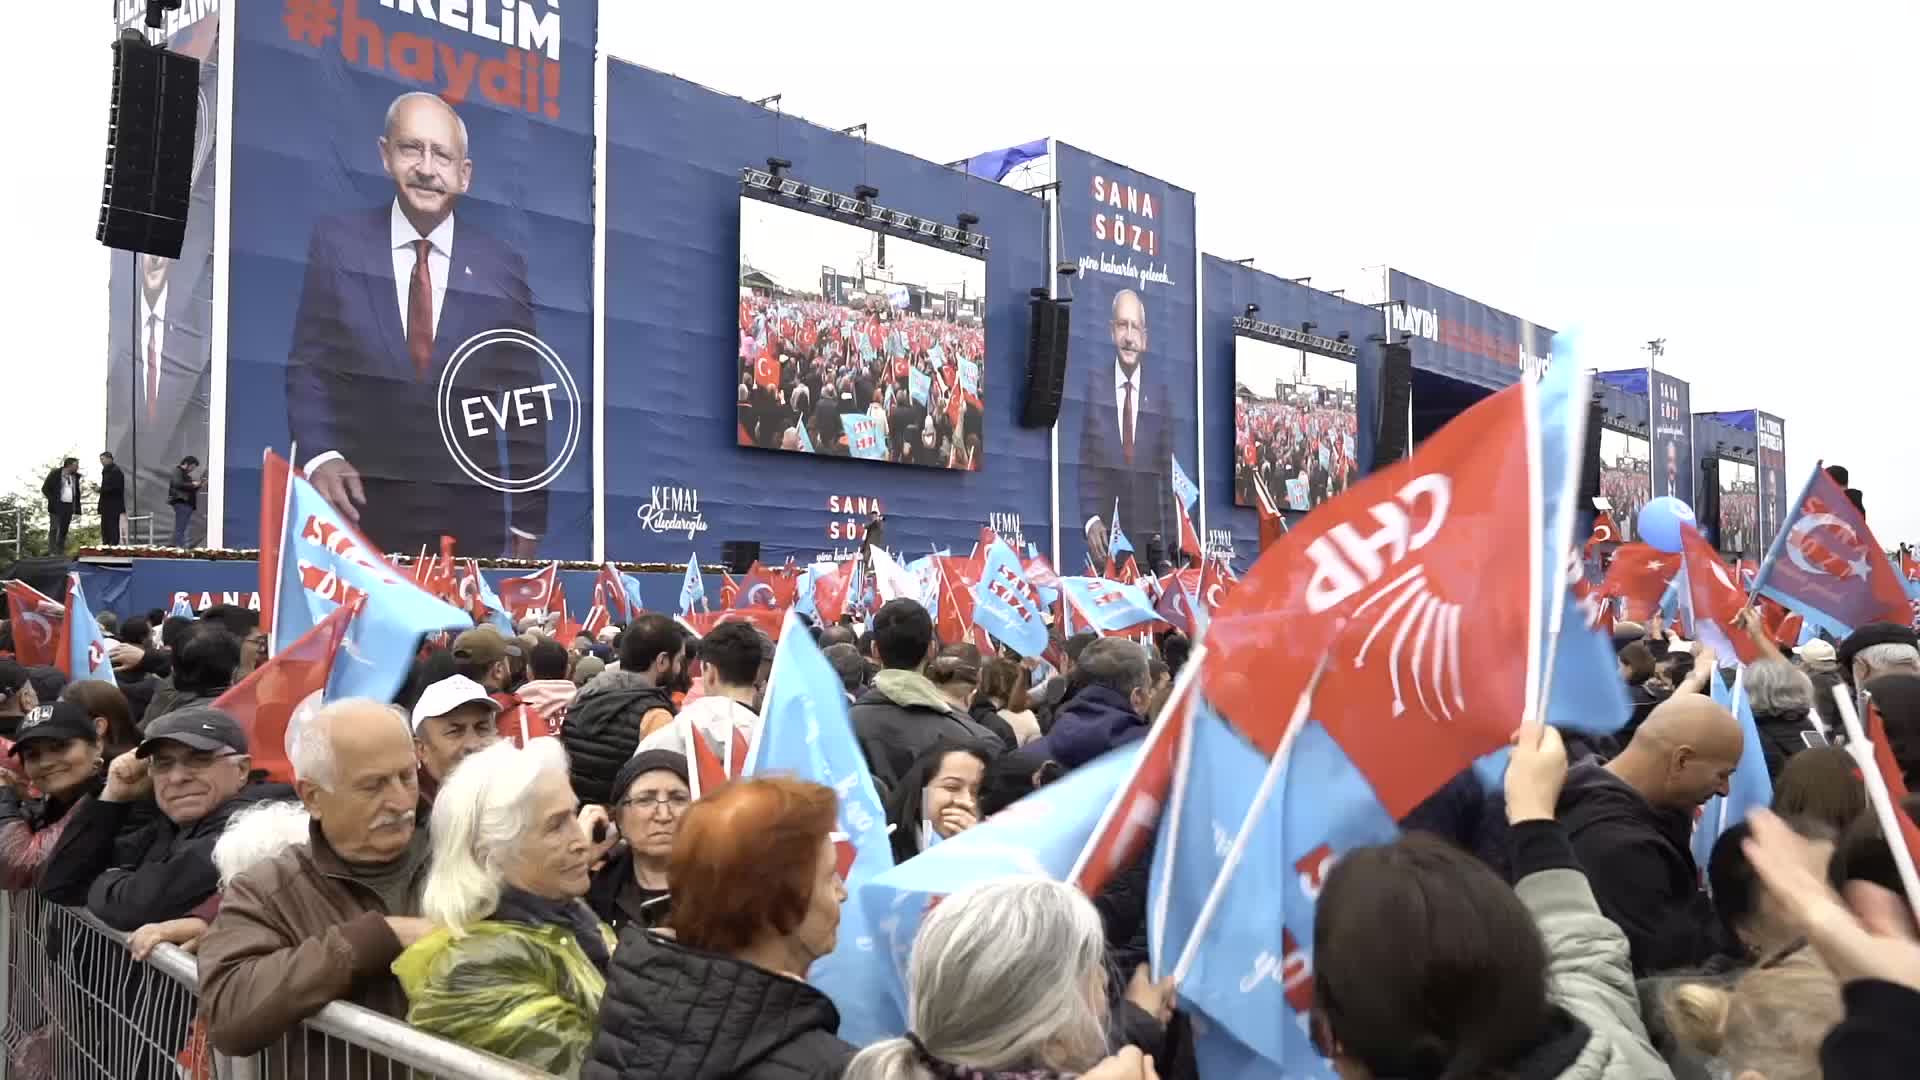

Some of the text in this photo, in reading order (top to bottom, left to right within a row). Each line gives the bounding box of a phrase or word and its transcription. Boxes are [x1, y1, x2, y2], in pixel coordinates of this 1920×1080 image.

[282, 0, 560, 119] #haydi!
[1094, 175, 1153, 219] SANA
[1095, 213, 1154, 256] SÖZ!
[1079, 255, 1099, 280] yine
[1101, 252, 1138, 278] baharlar
[461, 383, 557, 437] EVET
[651, 485, 699, 513] KEMAL
[830, 495, 881, 516] SANA
[1303, 473, 1451, 614] CHP
